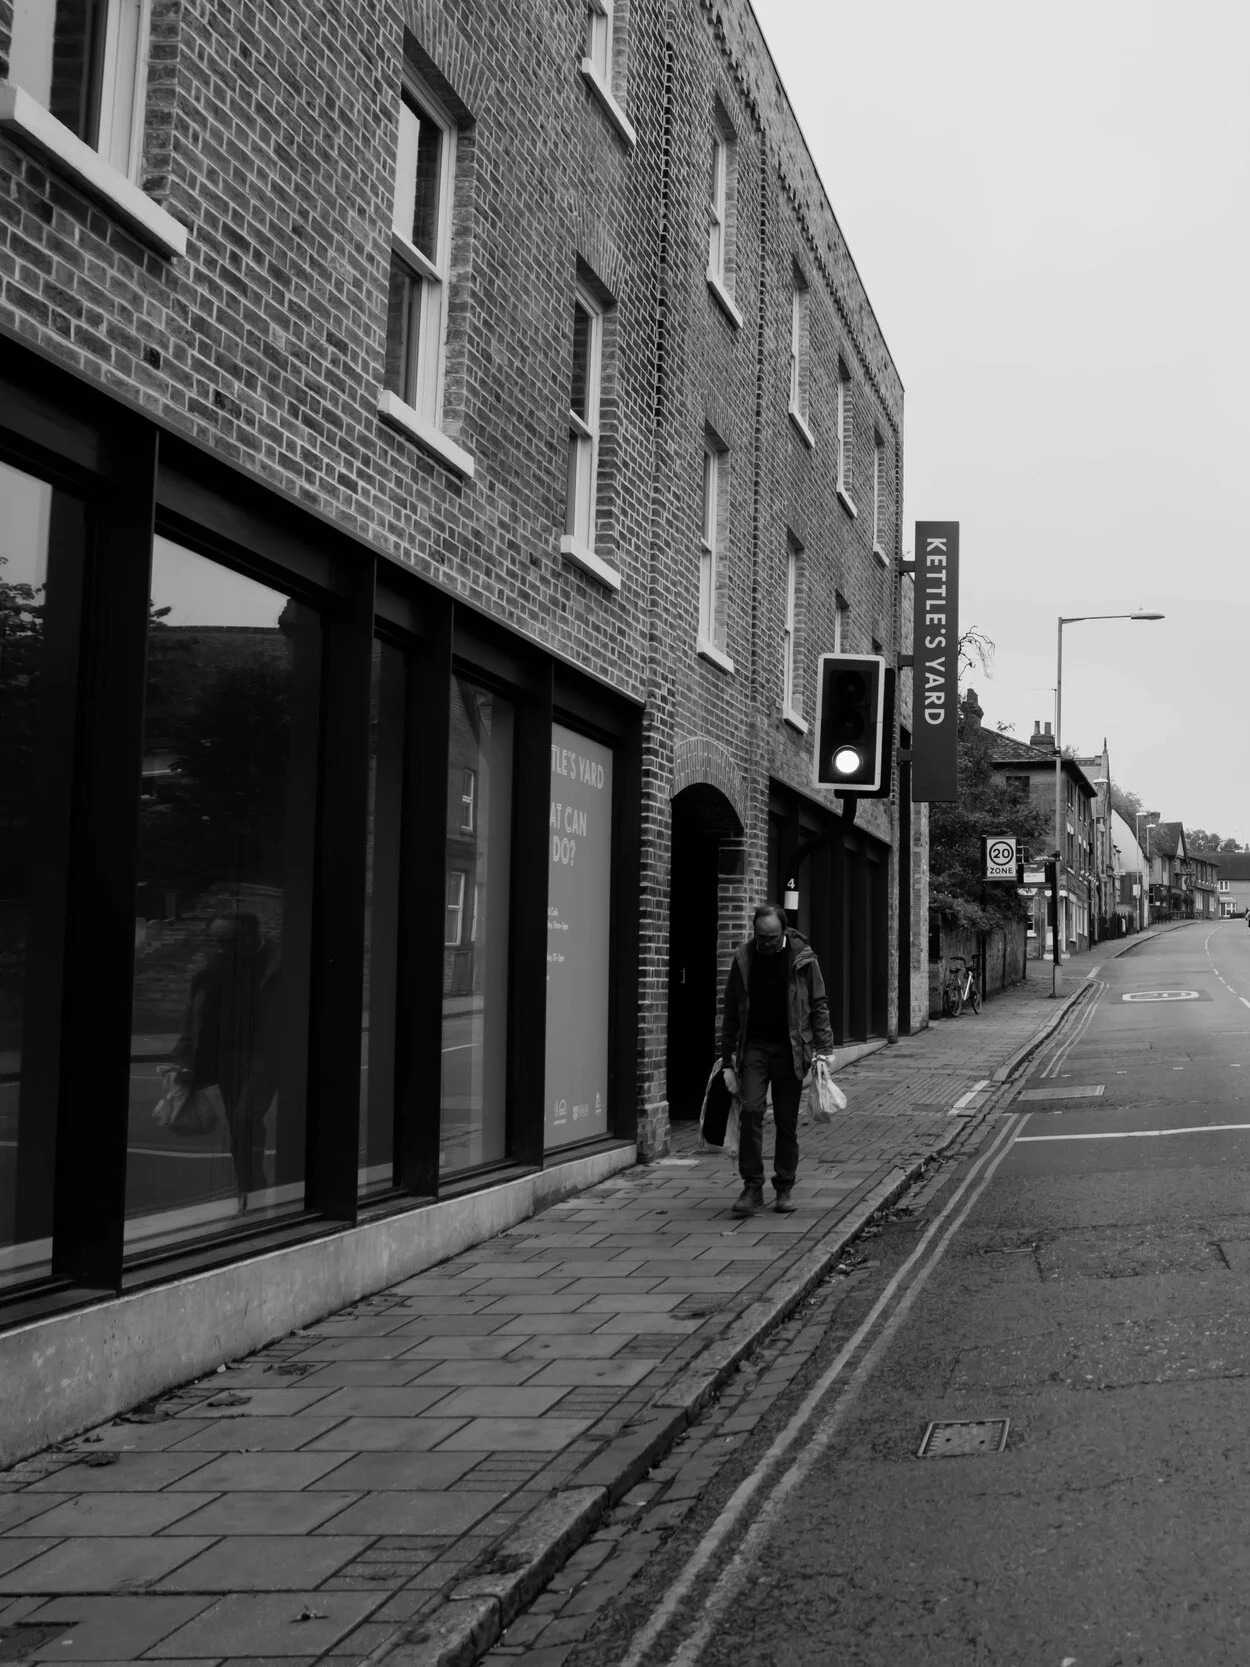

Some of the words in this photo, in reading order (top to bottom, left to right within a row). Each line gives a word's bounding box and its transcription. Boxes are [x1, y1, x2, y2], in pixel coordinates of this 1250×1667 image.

[925, 538, 947, 649] KETTLE'S
[924, 656, 946, 725] YARD
[578, 756, 604, 789] YARD
[565, 806, 587, 837] CAN
[553, 836, 576, 866] DO?
[993, 848, 1010, 858] 20
[787, 878, 795, 889] 4
